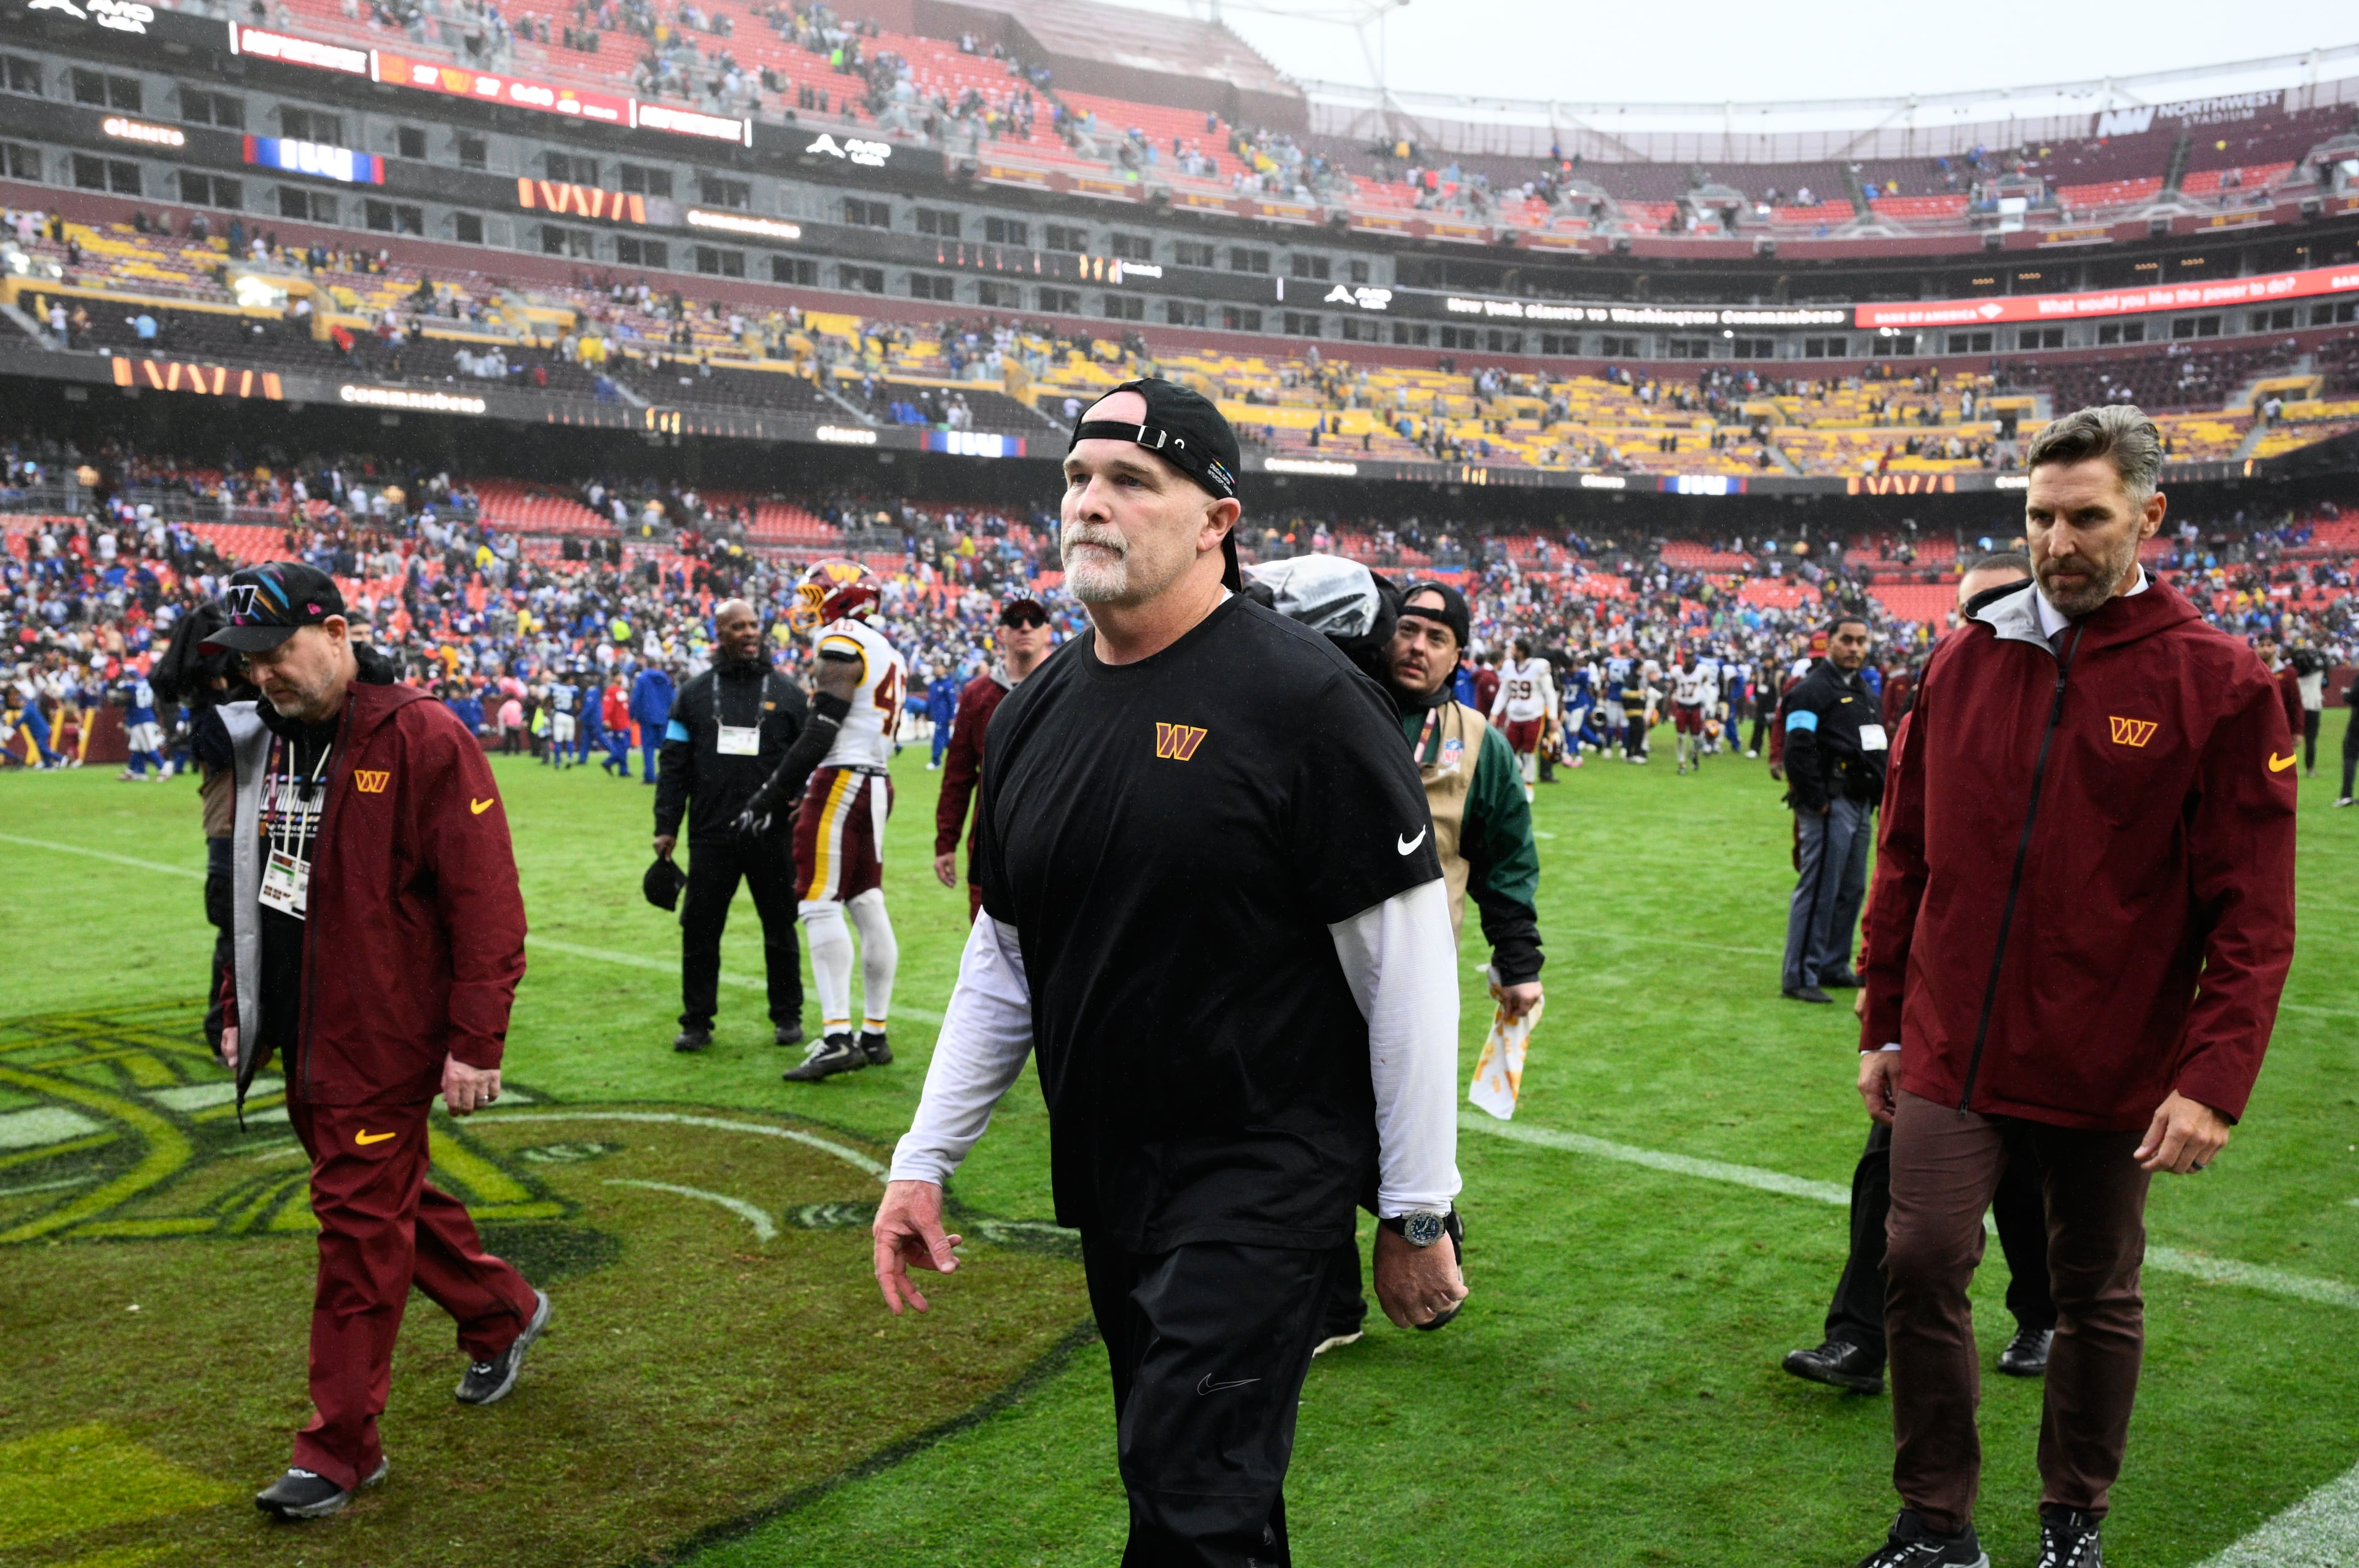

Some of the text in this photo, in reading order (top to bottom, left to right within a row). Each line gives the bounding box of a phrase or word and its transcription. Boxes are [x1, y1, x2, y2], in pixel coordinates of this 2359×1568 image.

[2158, 90, 2281, 119] NORTHWEST
[2097, 106, 2156, 138] NW
[2181, 109, 2256, 128] STADIUM
[2038, 276, 2296, 313] What would you like the power to do?
[2331, 275, 2359, 289] BAN
[1447, 298, 1483, 314] New
[1484, 301, 1524, 318] York
[1874, 309, 1978, 324] BANK OF AMERICA
[1156, 722, 1208, 762] W
[2109, 716, 2159, 748] W
[354, 769, 391, 794] W
